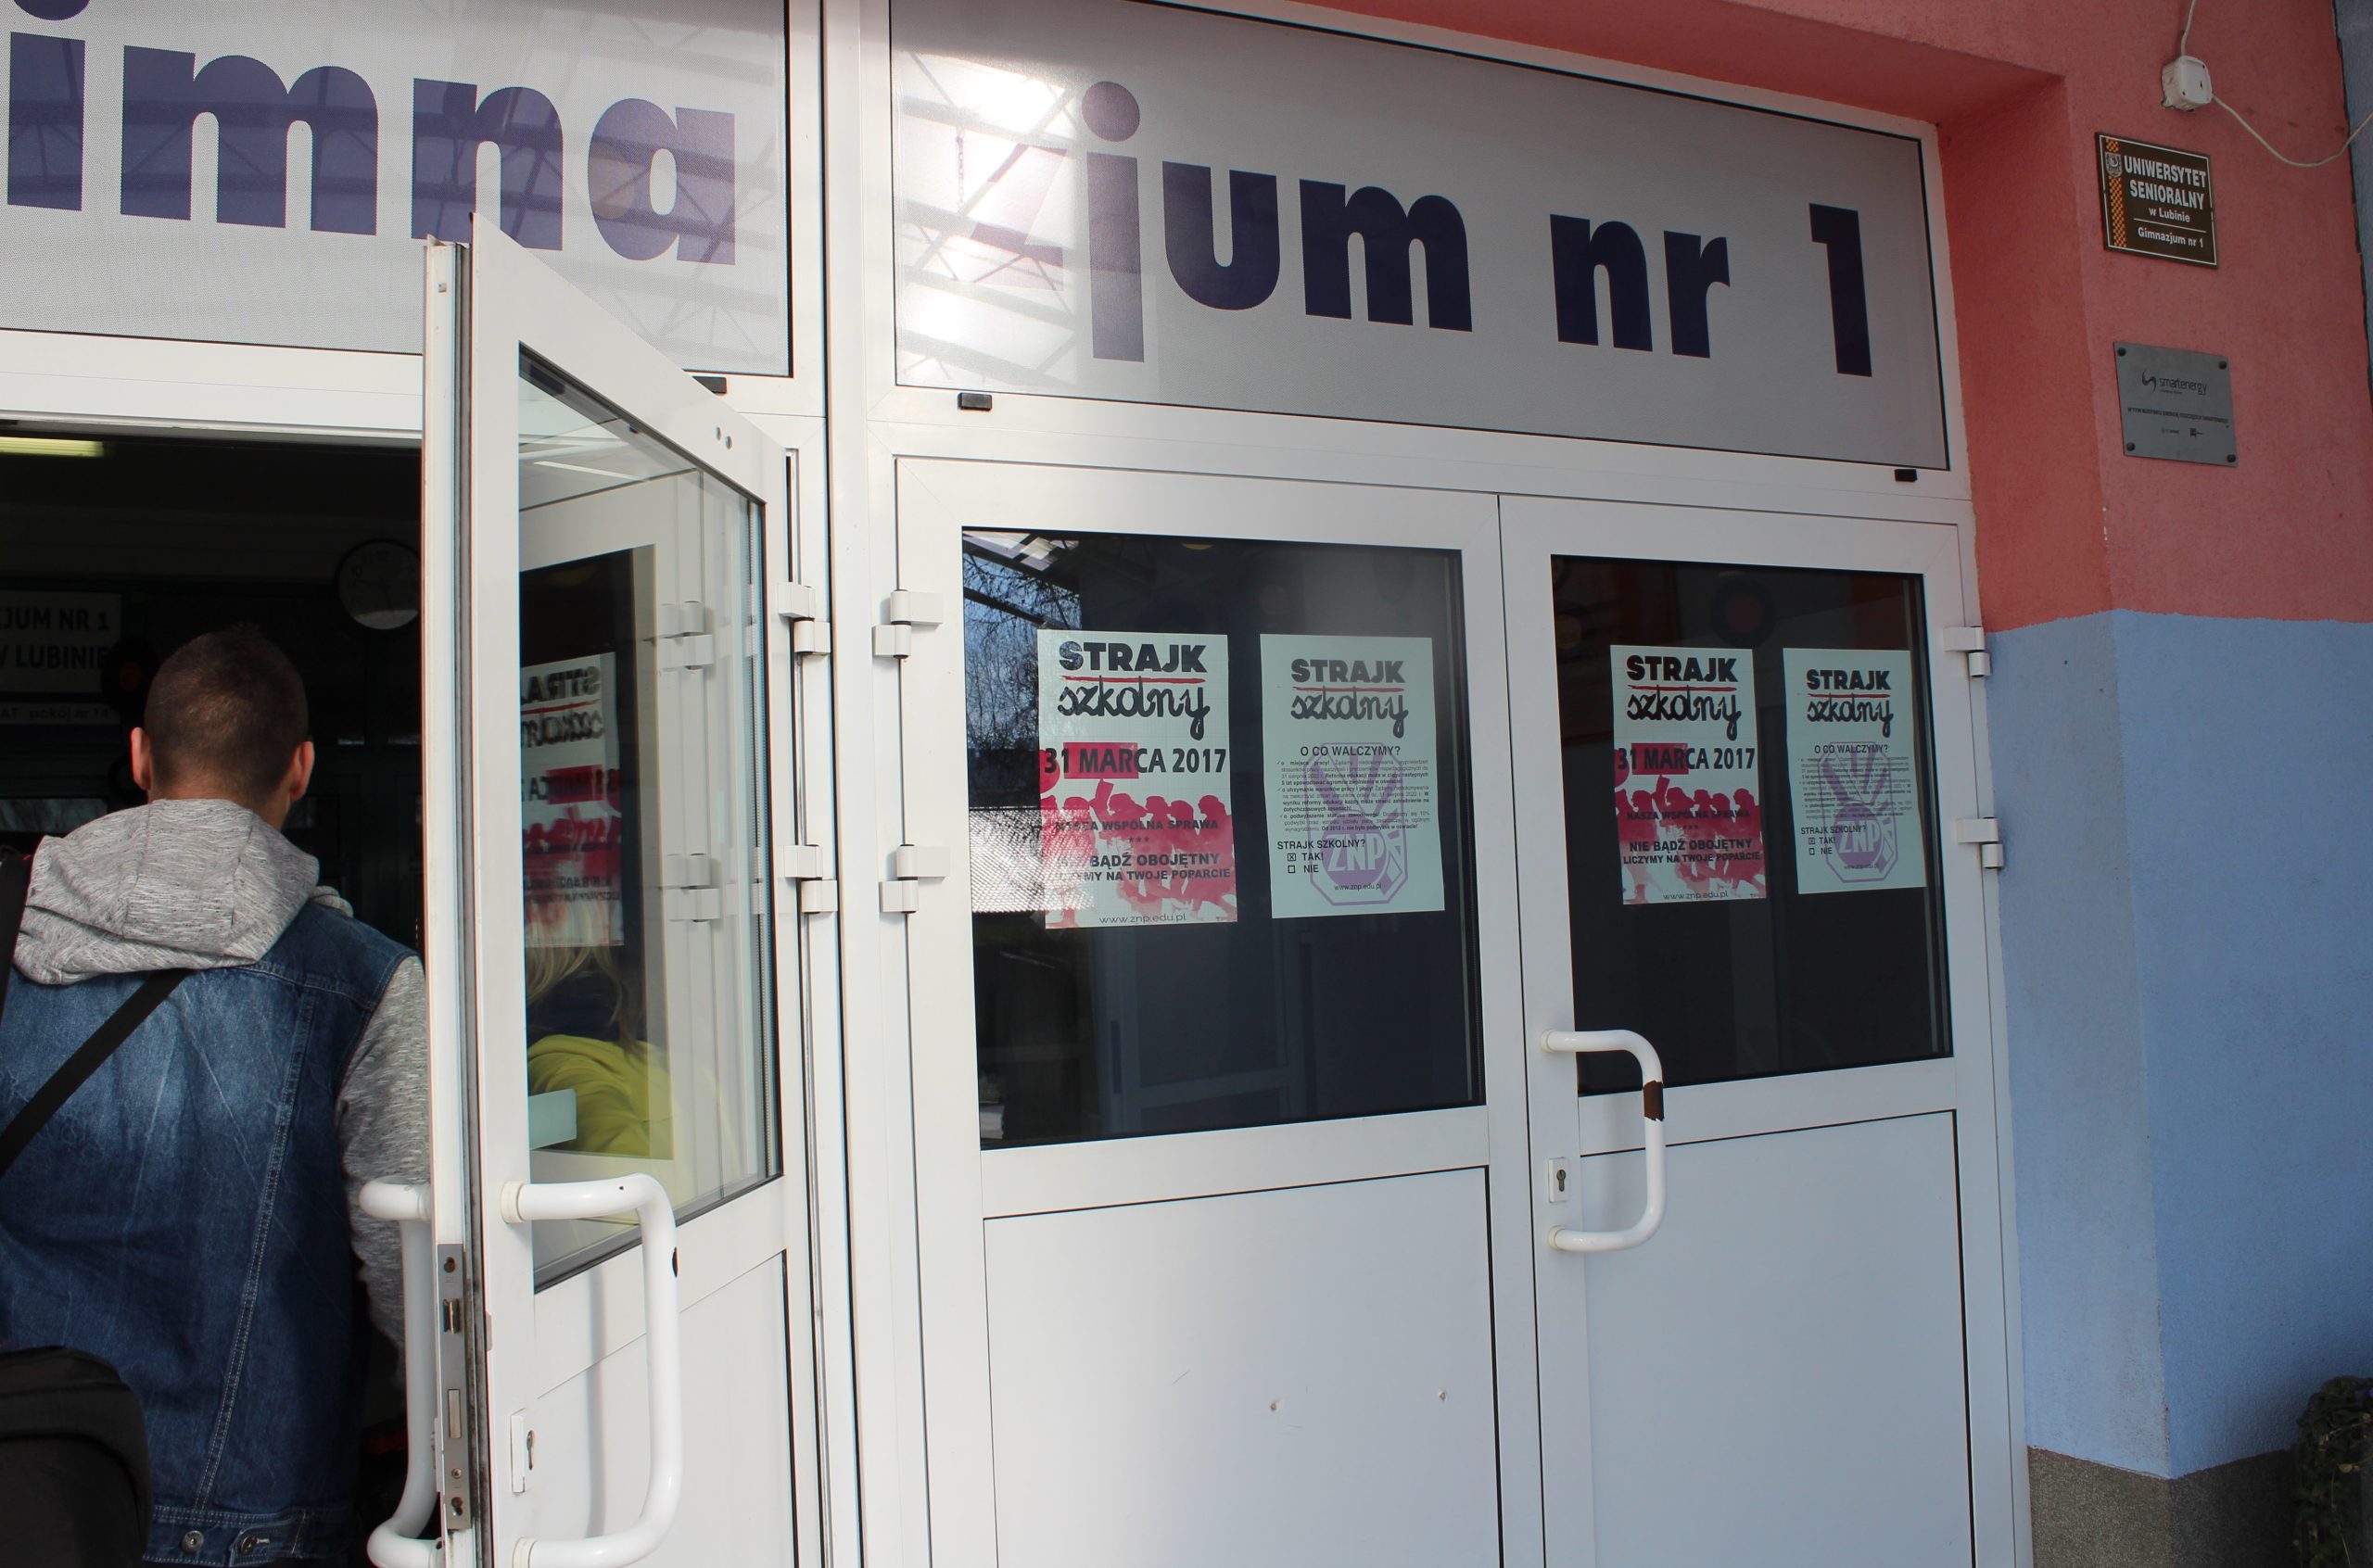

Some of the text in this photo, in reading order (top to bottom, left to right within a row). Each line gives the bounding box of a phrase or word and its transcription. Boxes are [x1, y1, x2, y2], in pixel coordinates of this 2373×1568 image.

[2124, 155, 2206, 188] UNIWERSYTET
[2129, 179, 2205, 209] SENIORALNY
[2149, 208, 2190, 222] w Lubinie
[2138, 227, 2203, 247] Gimnazjum nr 1
[1550, 213, 1731, 359] nr
[1808, 202, 1872, 377] 1
[2159, 377, 2207, 396] smartenergy
[0, 606, 109, 631] JUM NR 1
[1059, 640, 1208, 673] STRAJK
[1290, 658, 1405, 683] STRAJK
[1627, 654, 1739, 682] STRAJK
[1807, 668, 1891, 690] STRAJK
[1058, 675, 1211, 740] szkolny
[1290, 686, 1409, 738] szkolny
[1627, 684, 1742, 741] szkolny
[1807, 692, 1894, 738] szkolny
[1301, 745, 1401, 756] O CO WALCZYMY?
[1618, 747, 1756, 770] 31 MARCA 2017
[1814, 745, 1821, 753] O
[1822, 745, 1835, 753] CO
[1044, 748, 1226, 773] 31 MARCA 2017
[1167, 819, 1219, 830] SPRAWA
[1801, 825, 1867, 835] STRAJK SZKOLNY?
[1277, 839, 1365, 851] STRAJK SZKOLNY?
[1630, 838, 1753, 854] NIE BĄDŹ OBOJĘTNY
[1837, 820, 1882, 854] ZNP
[1090, 852, 1132, 870] BĄDŹ
[1136, 852, 1222, 868] OBOJĘTNY
[1301, 853, 1324, 861] TAK!
[1325, 833, 1386, 872] ZNP
[1623, 852, 1760, 865] LICZYMY NA TWOJE POPARCIE
[1107, 871, 1123, 881] NA
[1127, 870, 1168, 880] TWOJE
[1172, 868, 1231, 879] POPARCIE
[1303, 865, 1319, 873] NIE
[1663, 891, 1729, 901] www.znp.edu.pl
[1099, 912, 1187, 925] www.znp.edu.pl
